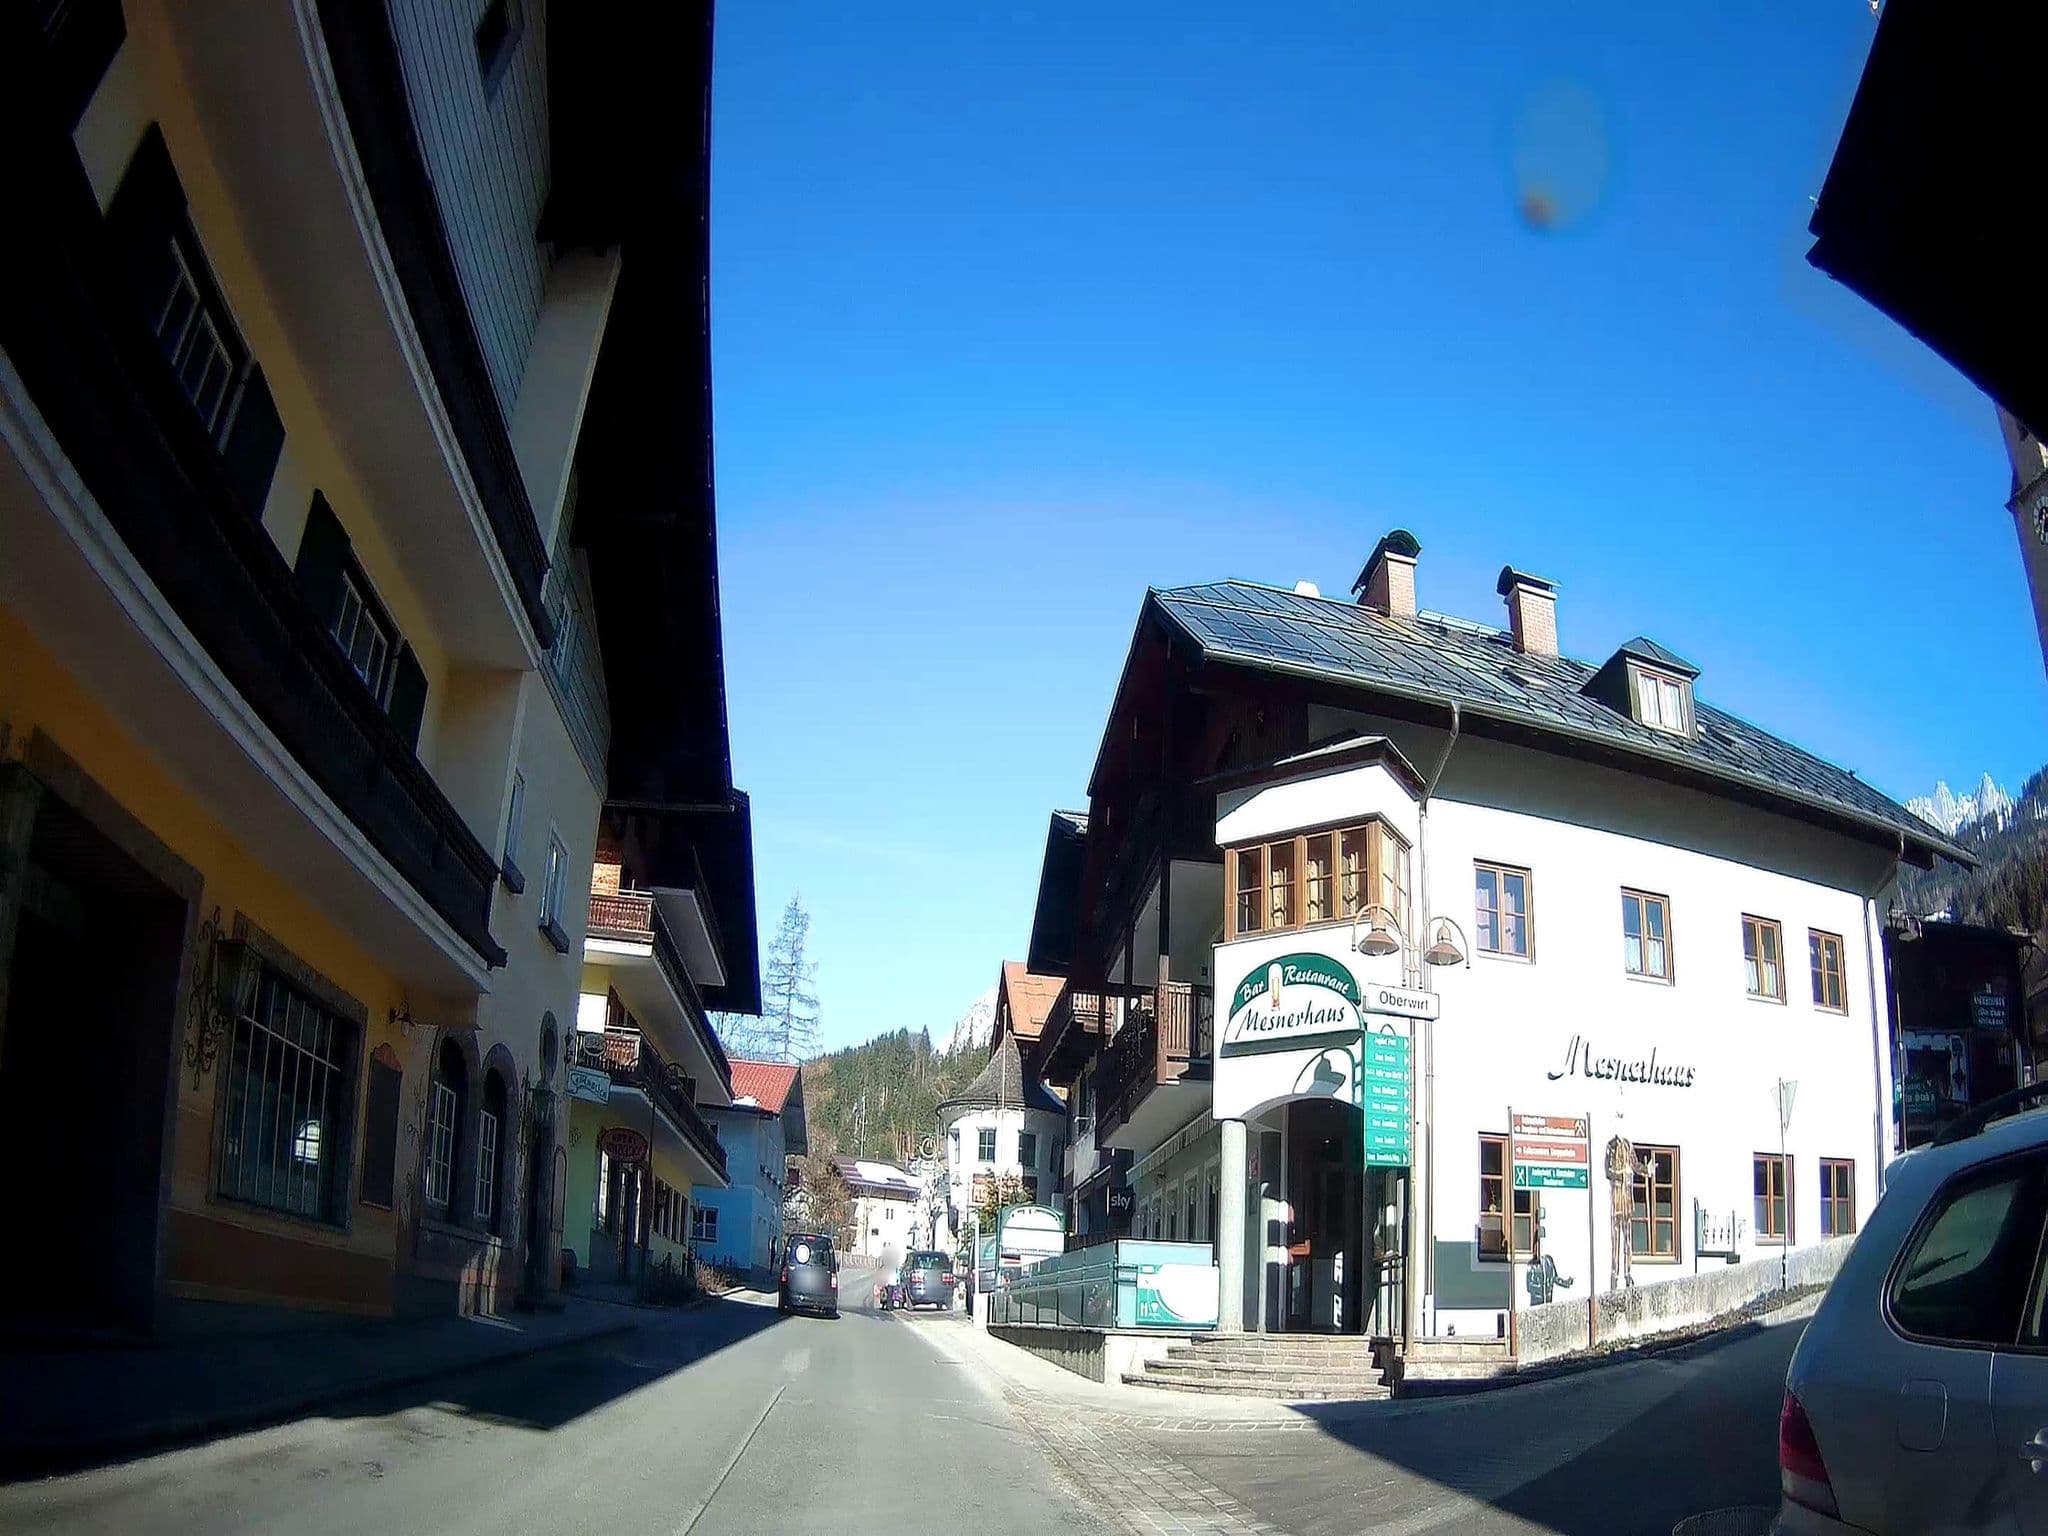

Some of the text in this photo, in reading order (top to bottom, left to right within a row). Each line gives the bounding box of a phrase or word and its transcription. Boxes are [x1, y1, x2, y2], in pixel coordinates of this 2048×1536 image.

[1239, 964, 1350, 1001] Bar Restaurant
[1379, 990, 1429, 1011] Oberwirt
[1235, 1001, 1345, 1040] Mesnerhaus
[1111, 1192, 1131, 1210] sky
